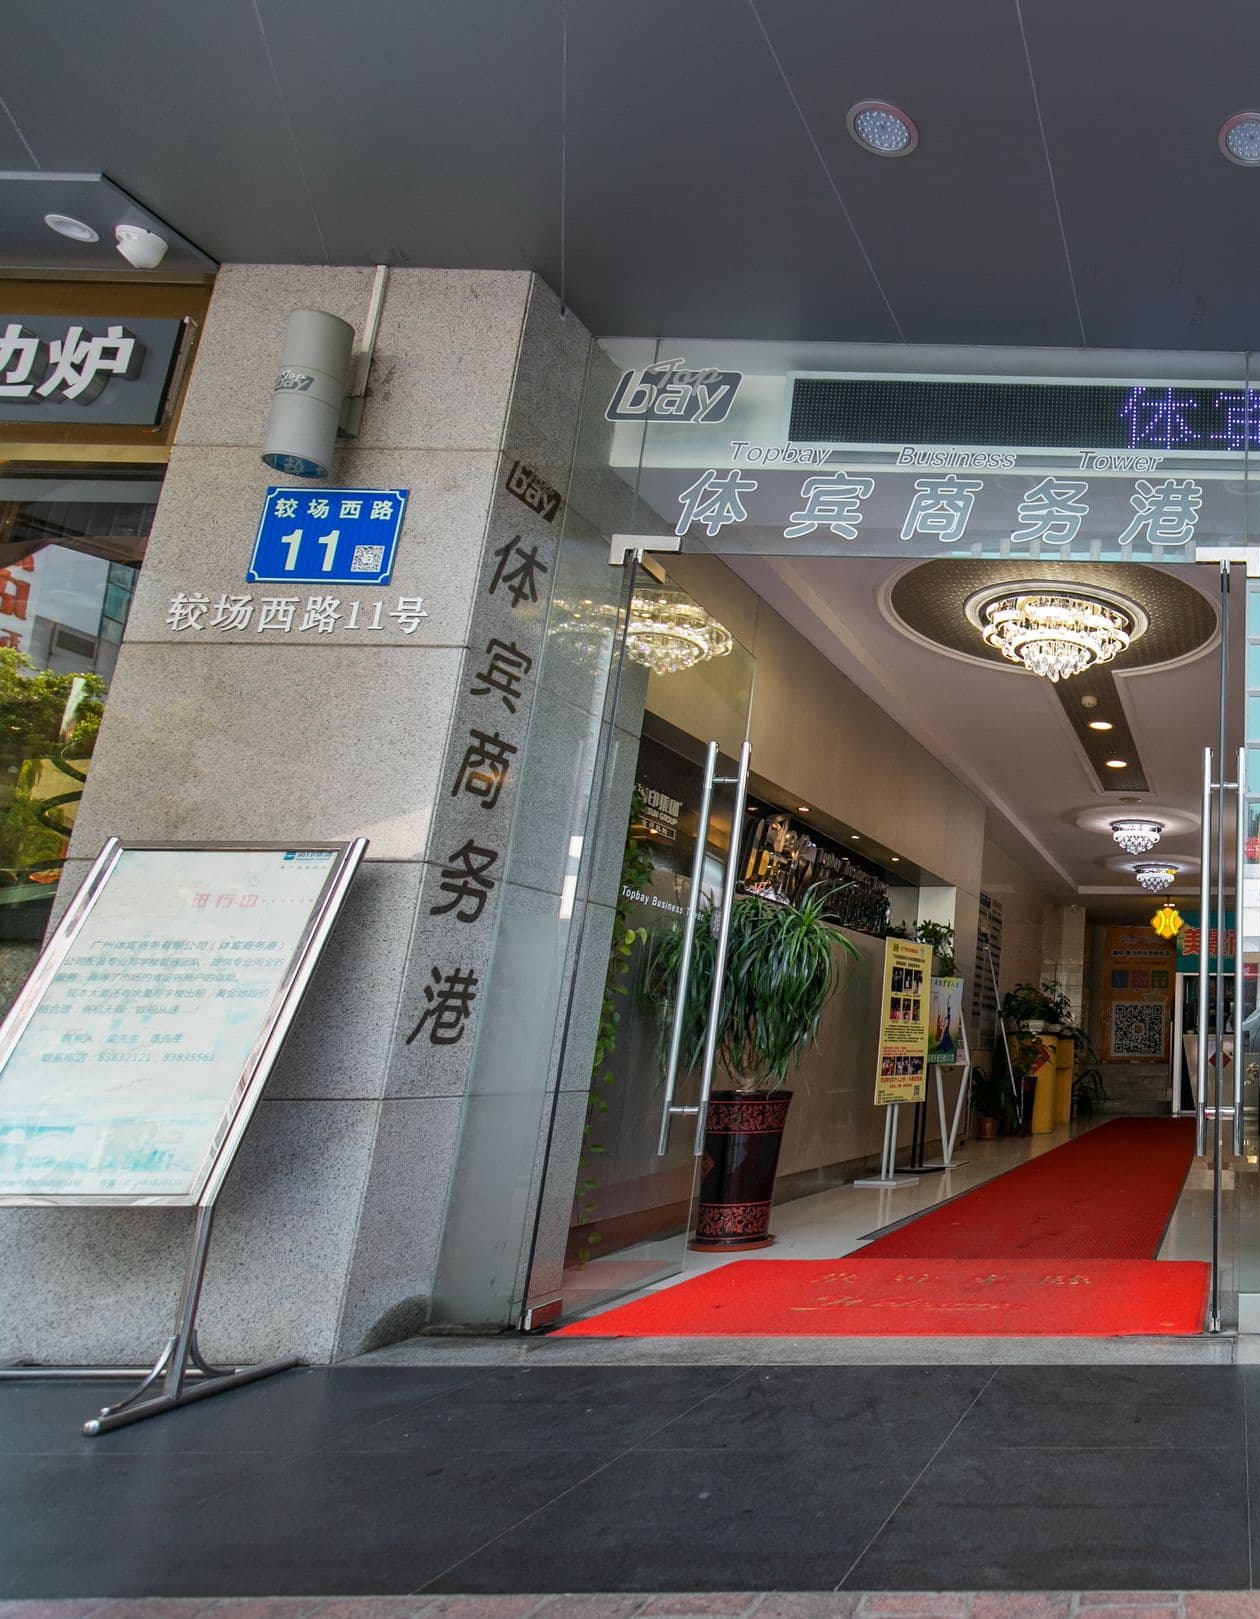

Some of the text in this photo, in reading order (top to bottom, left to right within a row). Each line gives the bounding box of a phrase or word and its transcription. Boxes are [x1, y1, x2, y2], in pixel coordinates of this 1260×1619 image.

[730, 440, 1163, 473] Topbay Business Tower
[274, 497, 394, 522] 较场西路
[675, 468, 1203, 546] 体宾商务港
[280, 528, 342, 572] 11
[165, 591, 429, 634] 较场西路11号
[406, 534, 548, 1046] 体宾商务港
[622, 885, 651, 906] Topbay
[652, 896, 684, 916] Business
